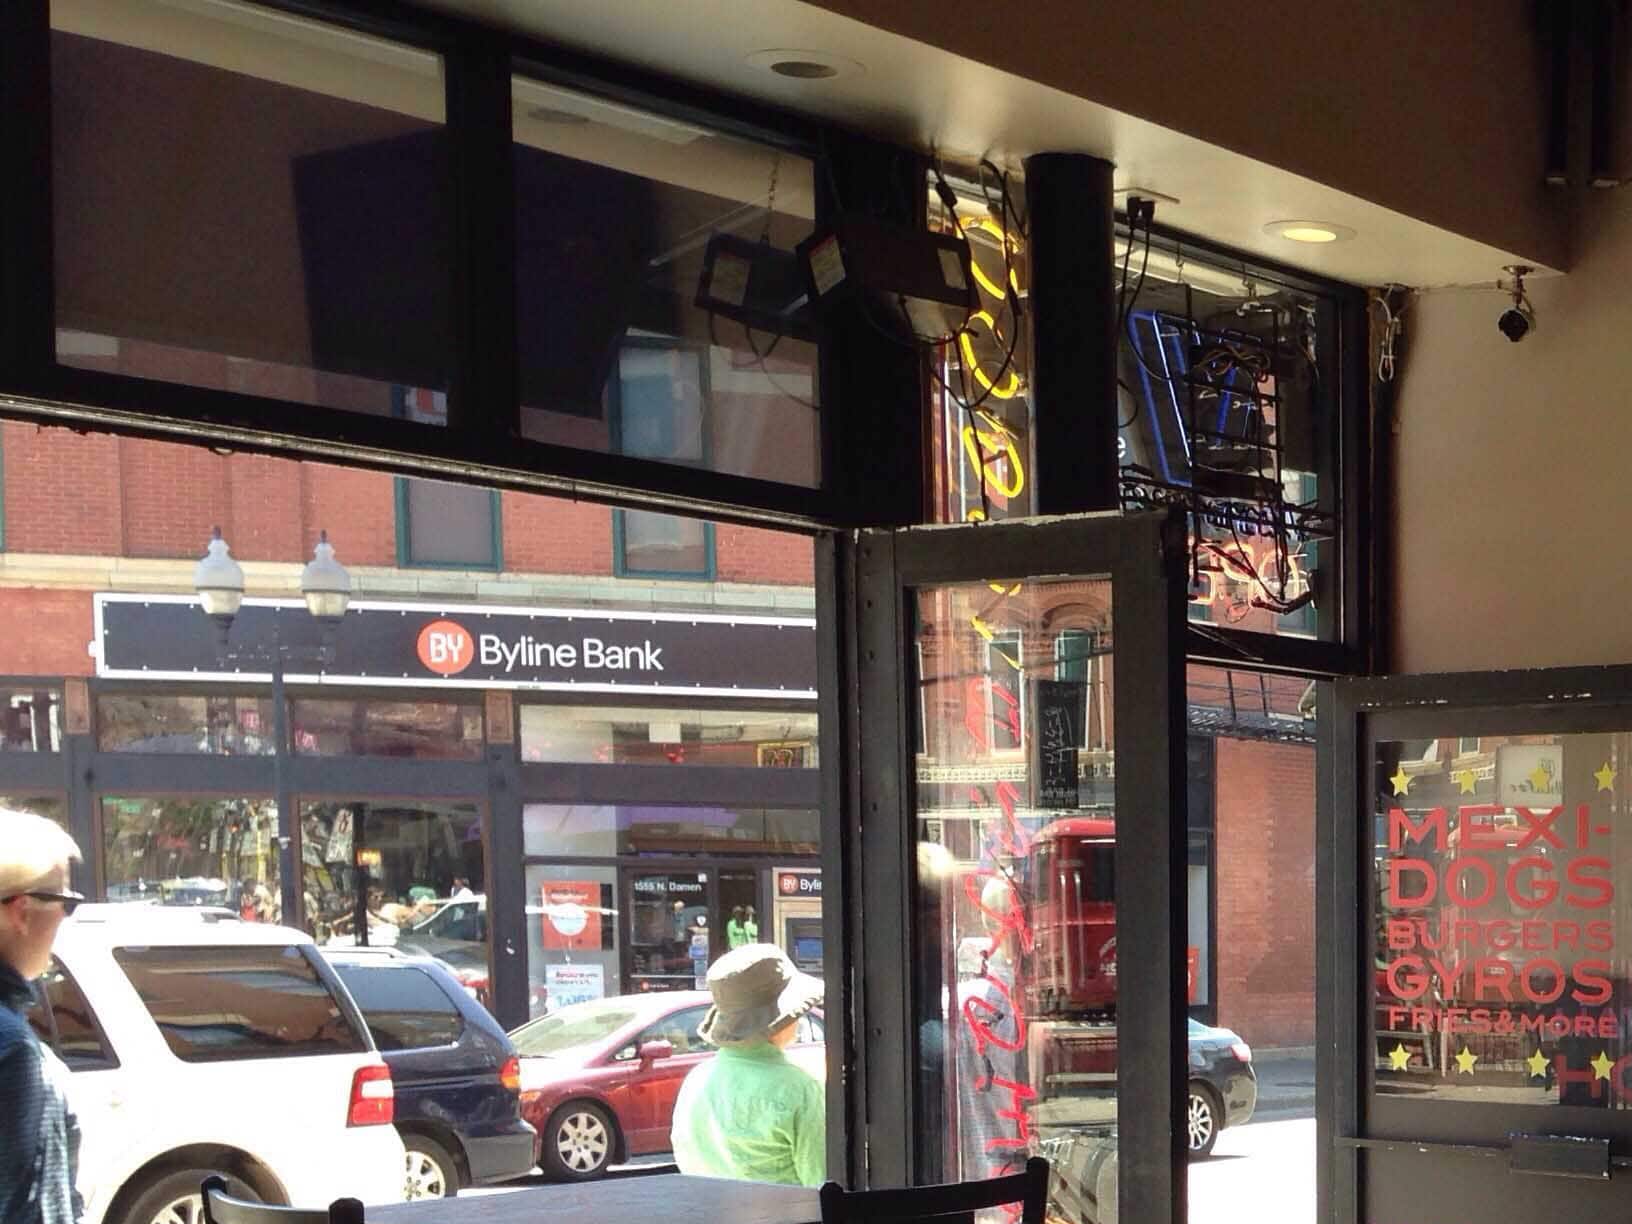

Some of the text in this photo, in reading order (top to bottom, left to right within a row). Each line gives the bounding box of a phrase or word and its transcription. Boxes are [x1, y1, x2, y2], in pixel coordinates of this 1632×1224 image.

[429, 632, 664, 672] BY Byline Bank
[1388, 805, 1612, 852] MEXI-
[669, 881, 702, 892] Damen
[1388, 856, 1615, 909] DOGS
[1388, 918, 1614, 952] BURGERS
[1386, 954, 1613, 1006] GYROS
